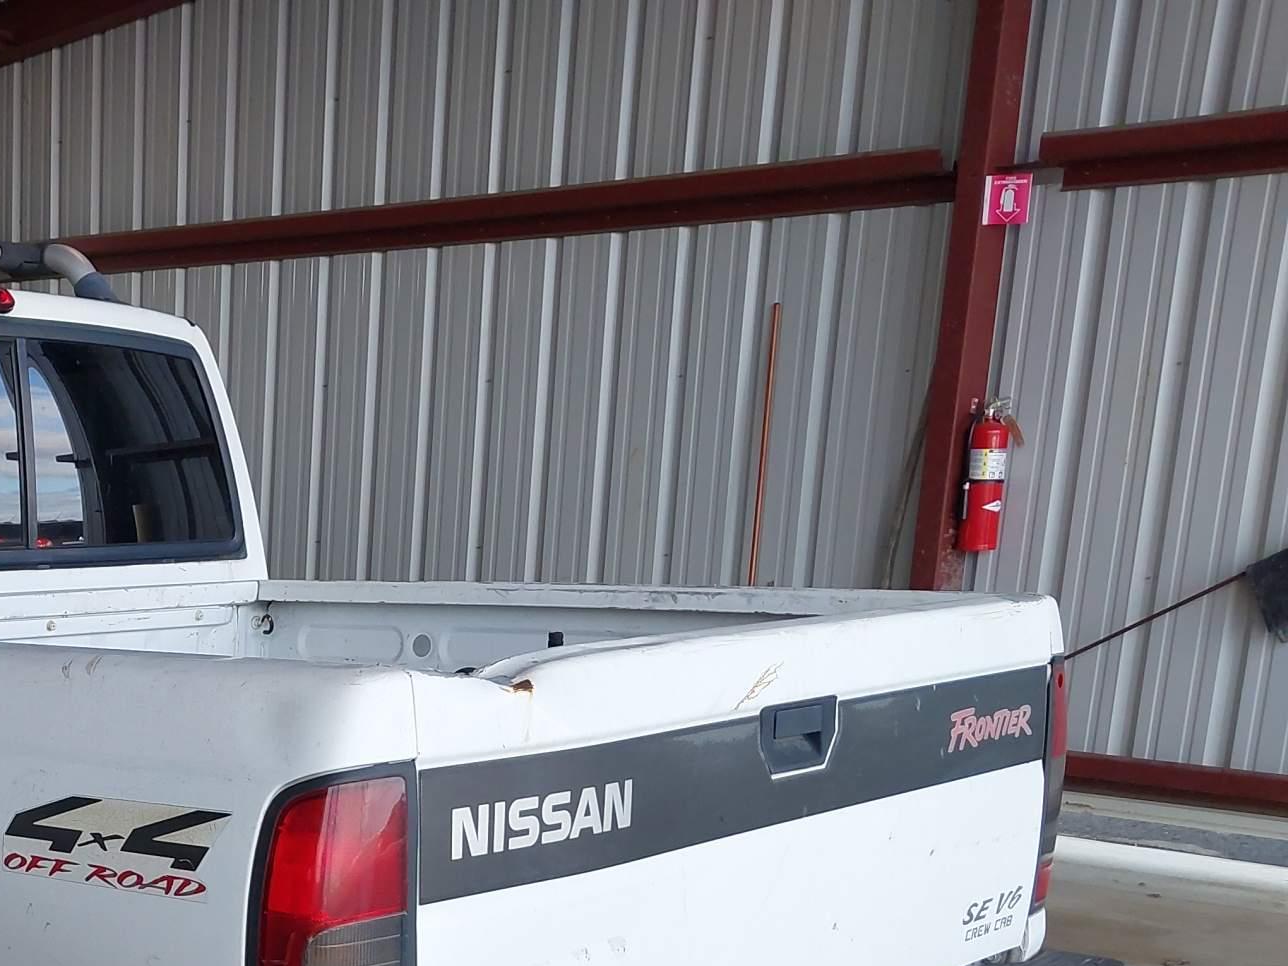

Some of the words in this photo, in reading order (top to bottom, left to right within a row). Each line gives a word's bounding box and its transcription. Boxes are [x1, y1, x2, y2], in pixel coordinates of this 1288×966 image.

[948, 704, 1032, 752] FRONTIER
[451, 778, 633, 861] NISSAN
[3, 853, 81, 877] OFF
[85, 864, 207, 897] ROAD
[962, 898, 993, 925] SE
[996, 886, 1023, 914] V6
[965, 922, 991, 942] CREW
[994, 915, 1013, 931] CAB
